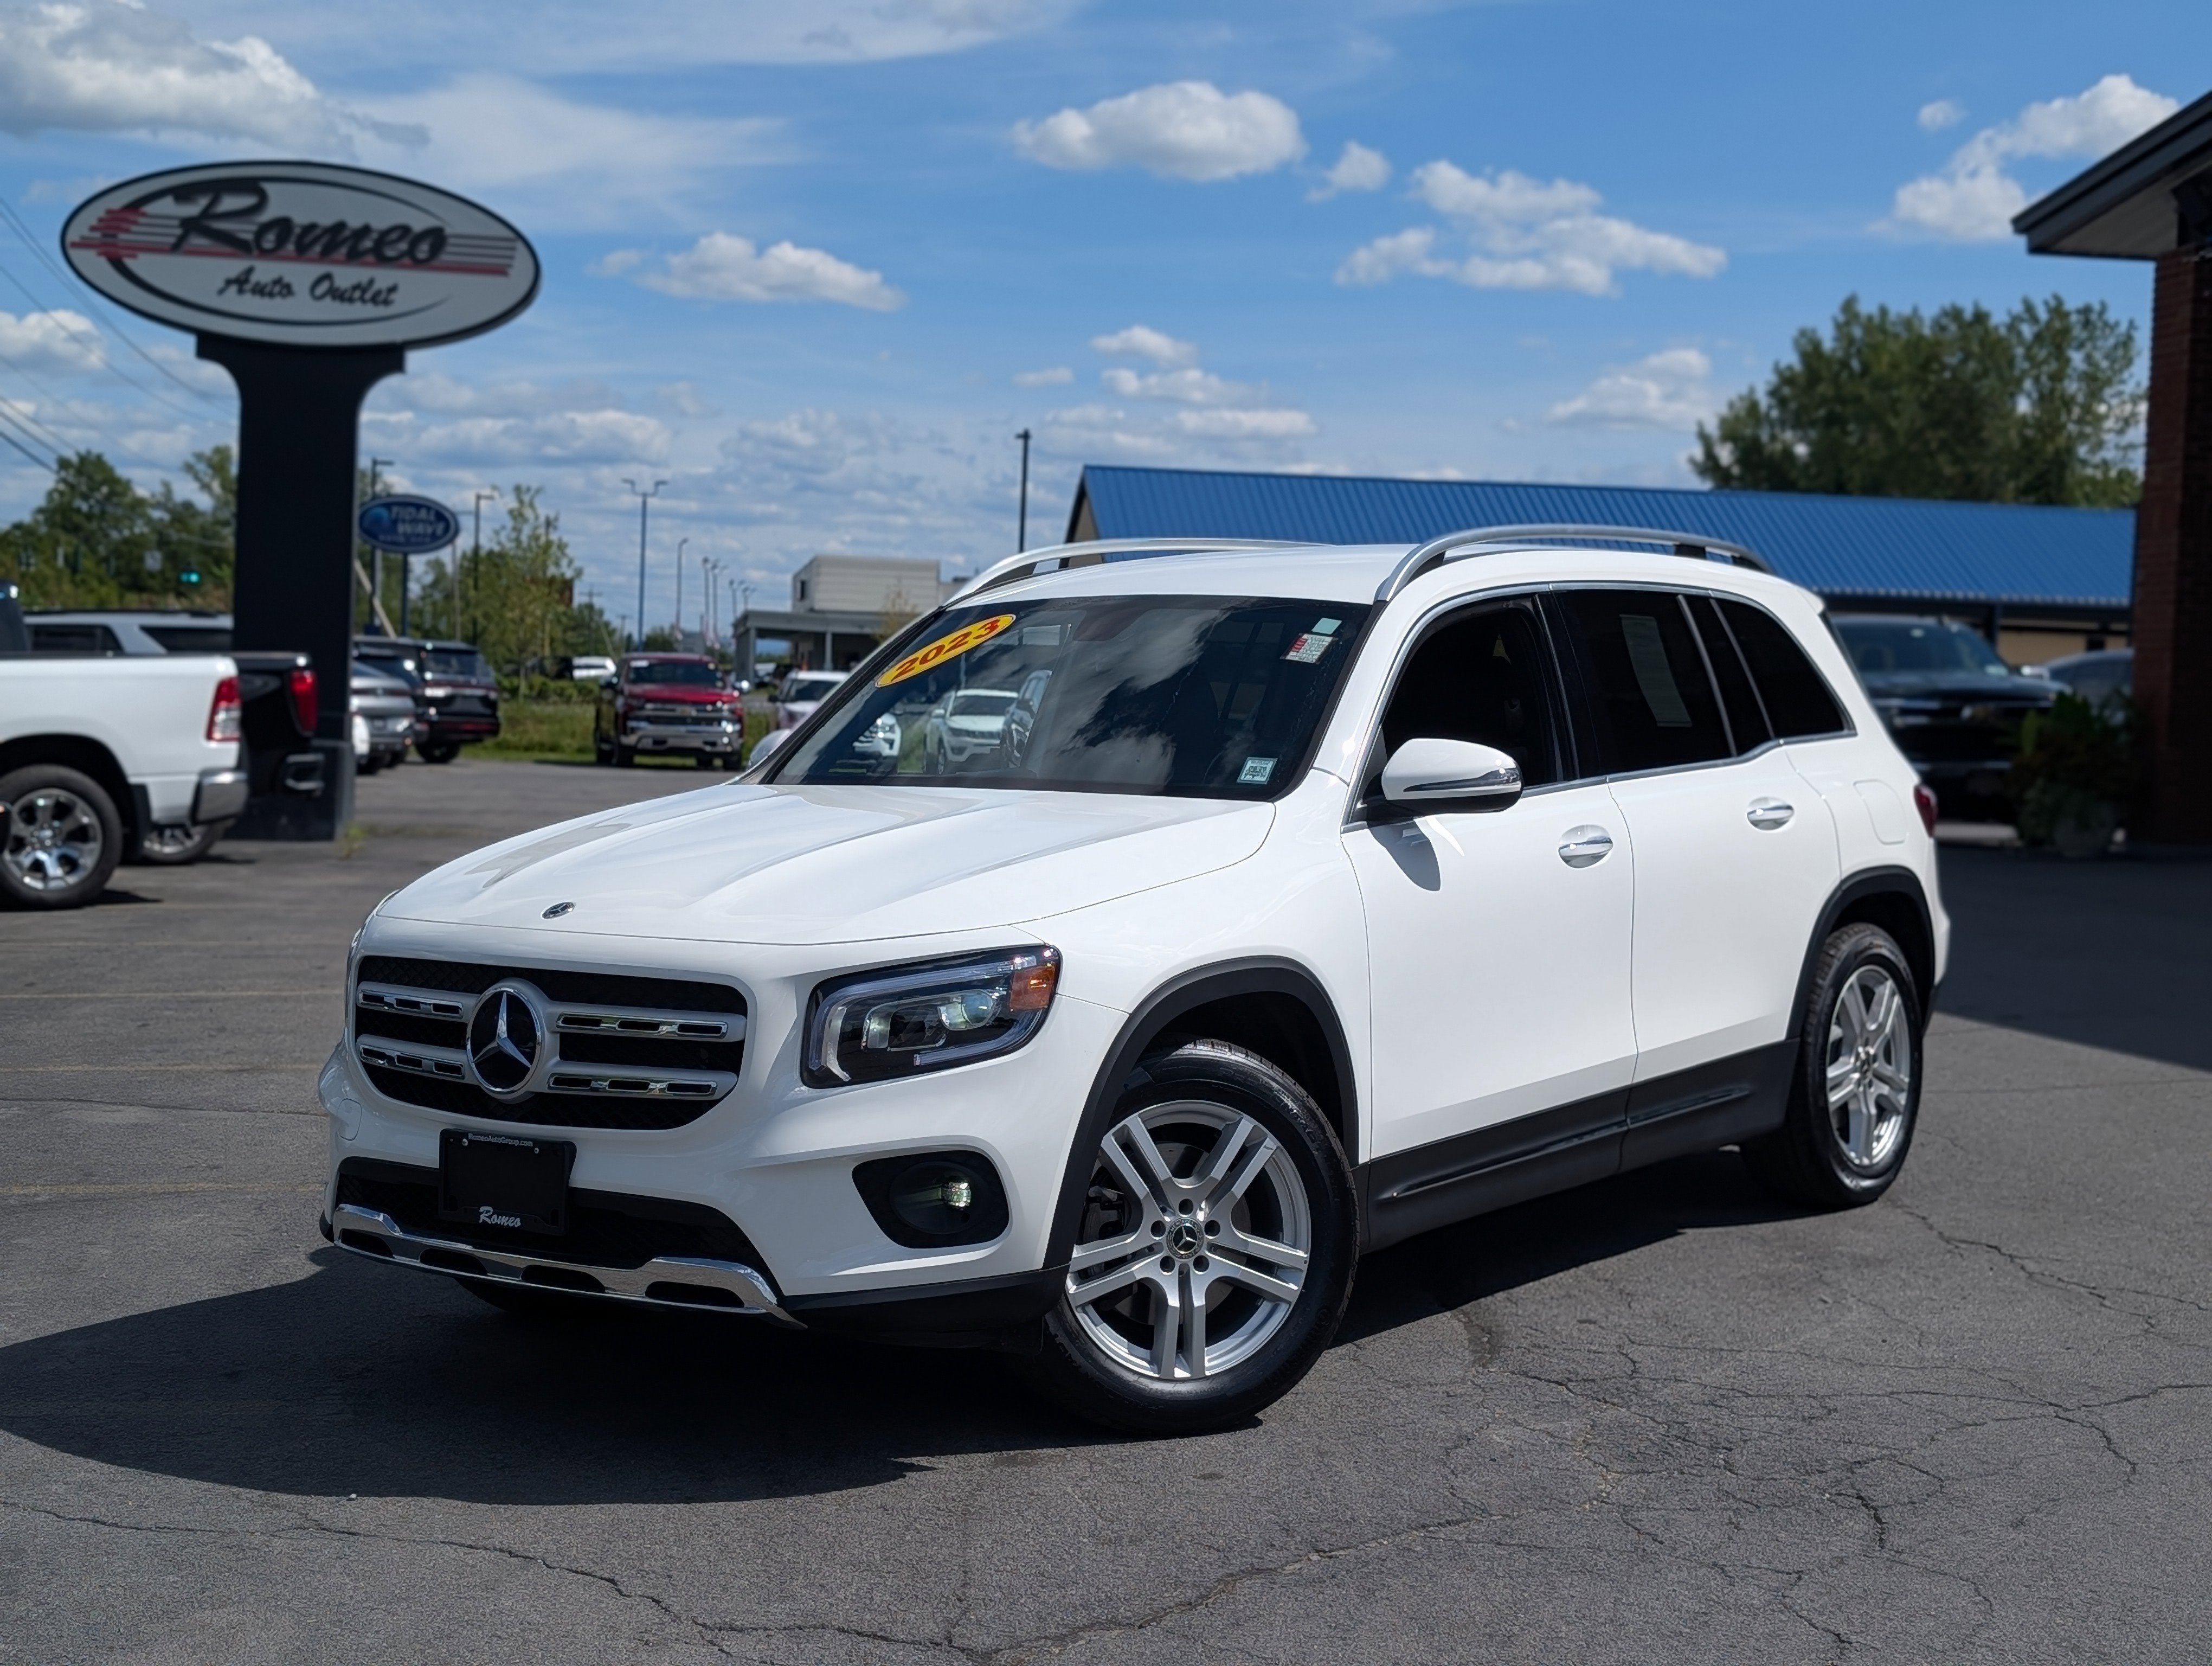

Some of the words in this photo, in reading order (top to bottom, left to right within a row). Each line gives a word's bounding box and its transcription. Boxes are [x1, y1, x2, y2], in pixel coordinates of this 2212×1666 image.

[172, 180, 446, 264] Romeo
[217, 265, 294, 299] Auto
[310, 272, 398, 307] Outlet
[890, 619, 1001, 682] 2023
[479, 1206, 521, 1227] Romeo
